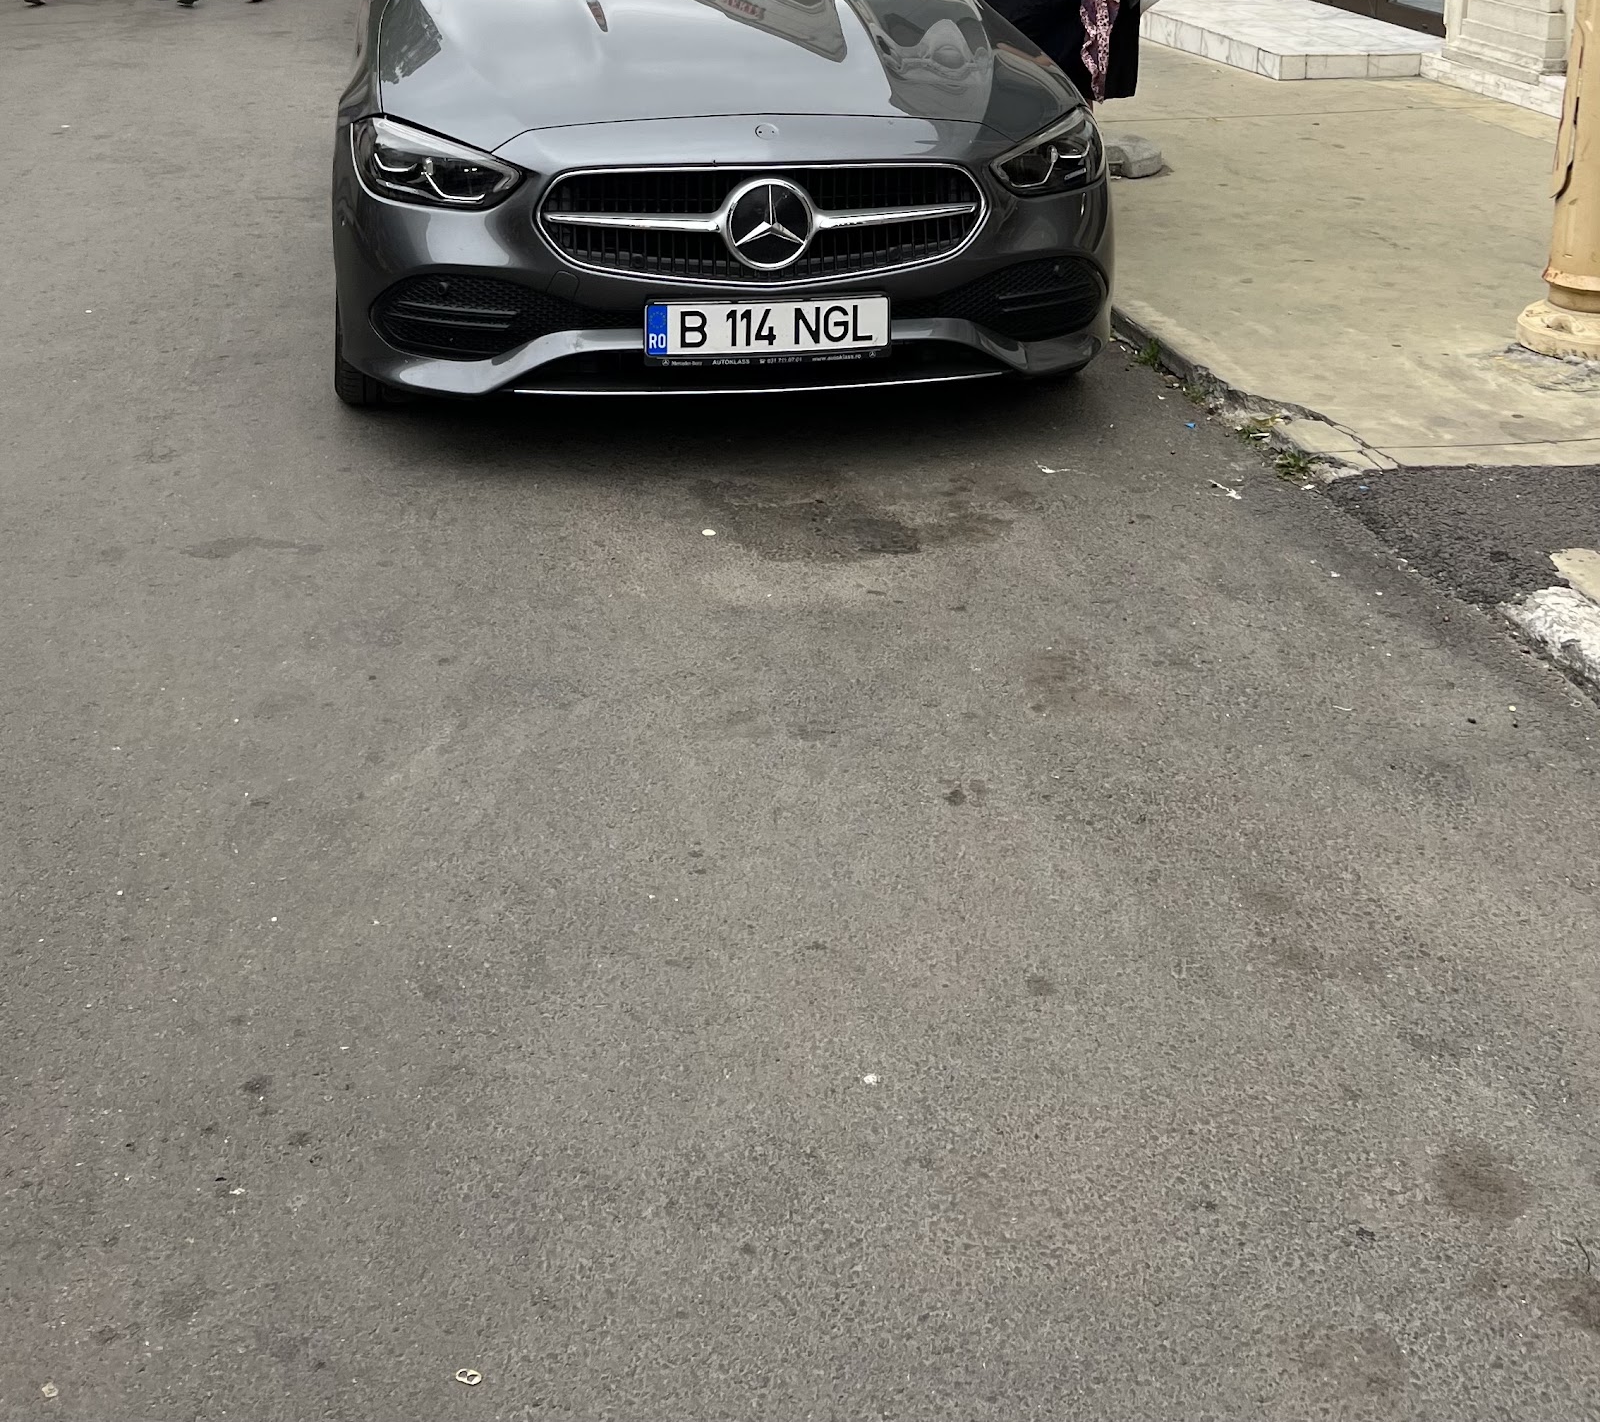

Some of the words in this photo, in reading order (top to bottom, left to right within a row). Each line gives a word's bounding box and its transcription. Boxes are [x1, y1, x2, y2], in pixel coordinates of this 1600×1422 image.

[680, 311, 707, 348] B
[726, 309, 776, 347] 114
[794, 305, 873, 345] NGL
[649, 334, 666, 349] RO
